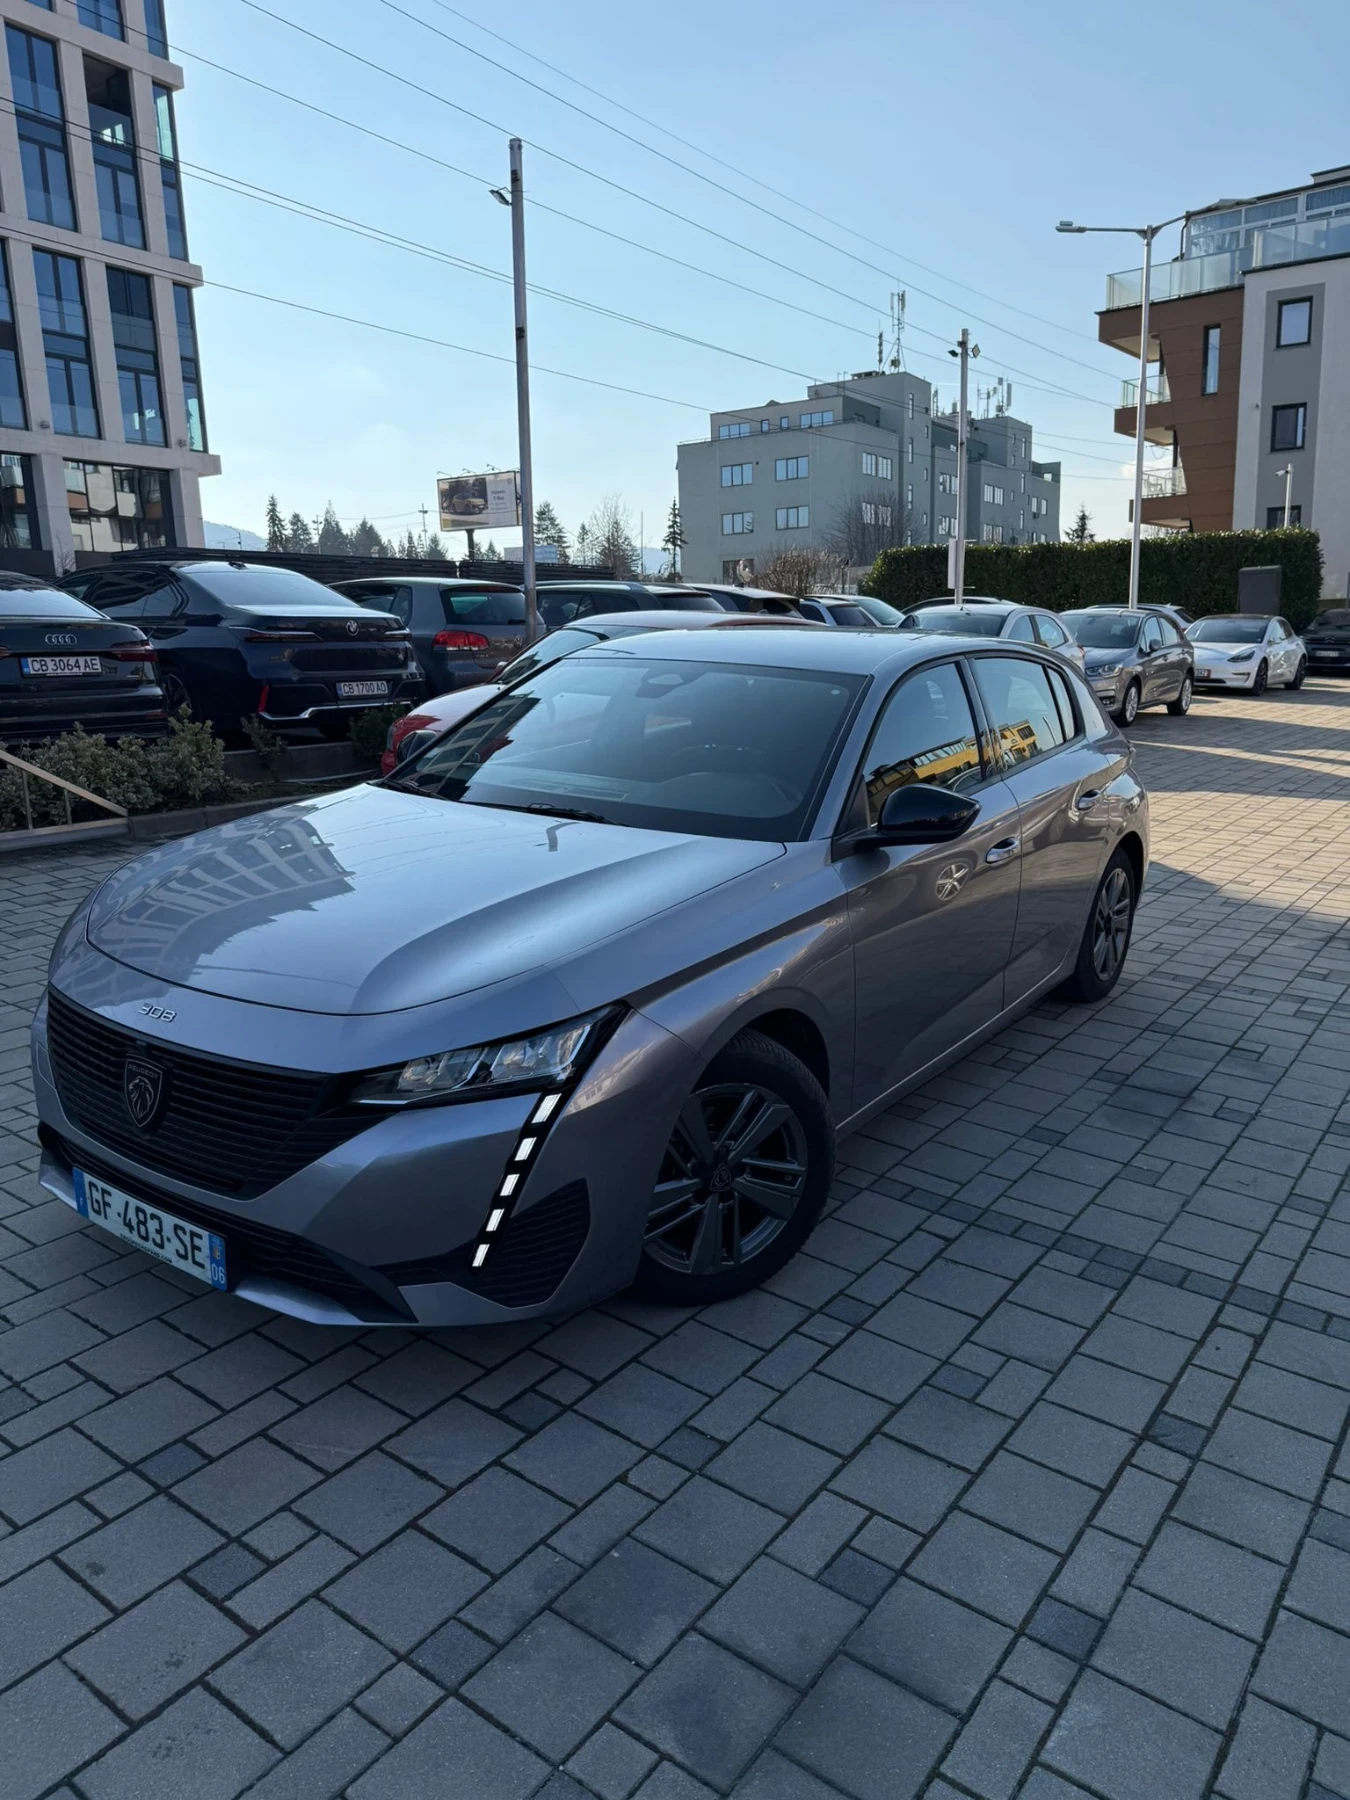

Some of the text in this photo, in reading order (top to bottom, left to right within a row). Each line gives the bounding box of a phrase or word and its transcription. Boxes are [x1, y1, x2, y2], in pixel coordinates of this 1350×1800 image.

[31, 659, 49, 673] CB
[51, 658, 81, 672] 3064
[84, 657, 99, 671] AE
[342, 683, 354, 695] CB
[356, 682, 375, 693] 1700
[138, 1002, 177, 1023] 308
[211, 1263, 226, 1285] 06
